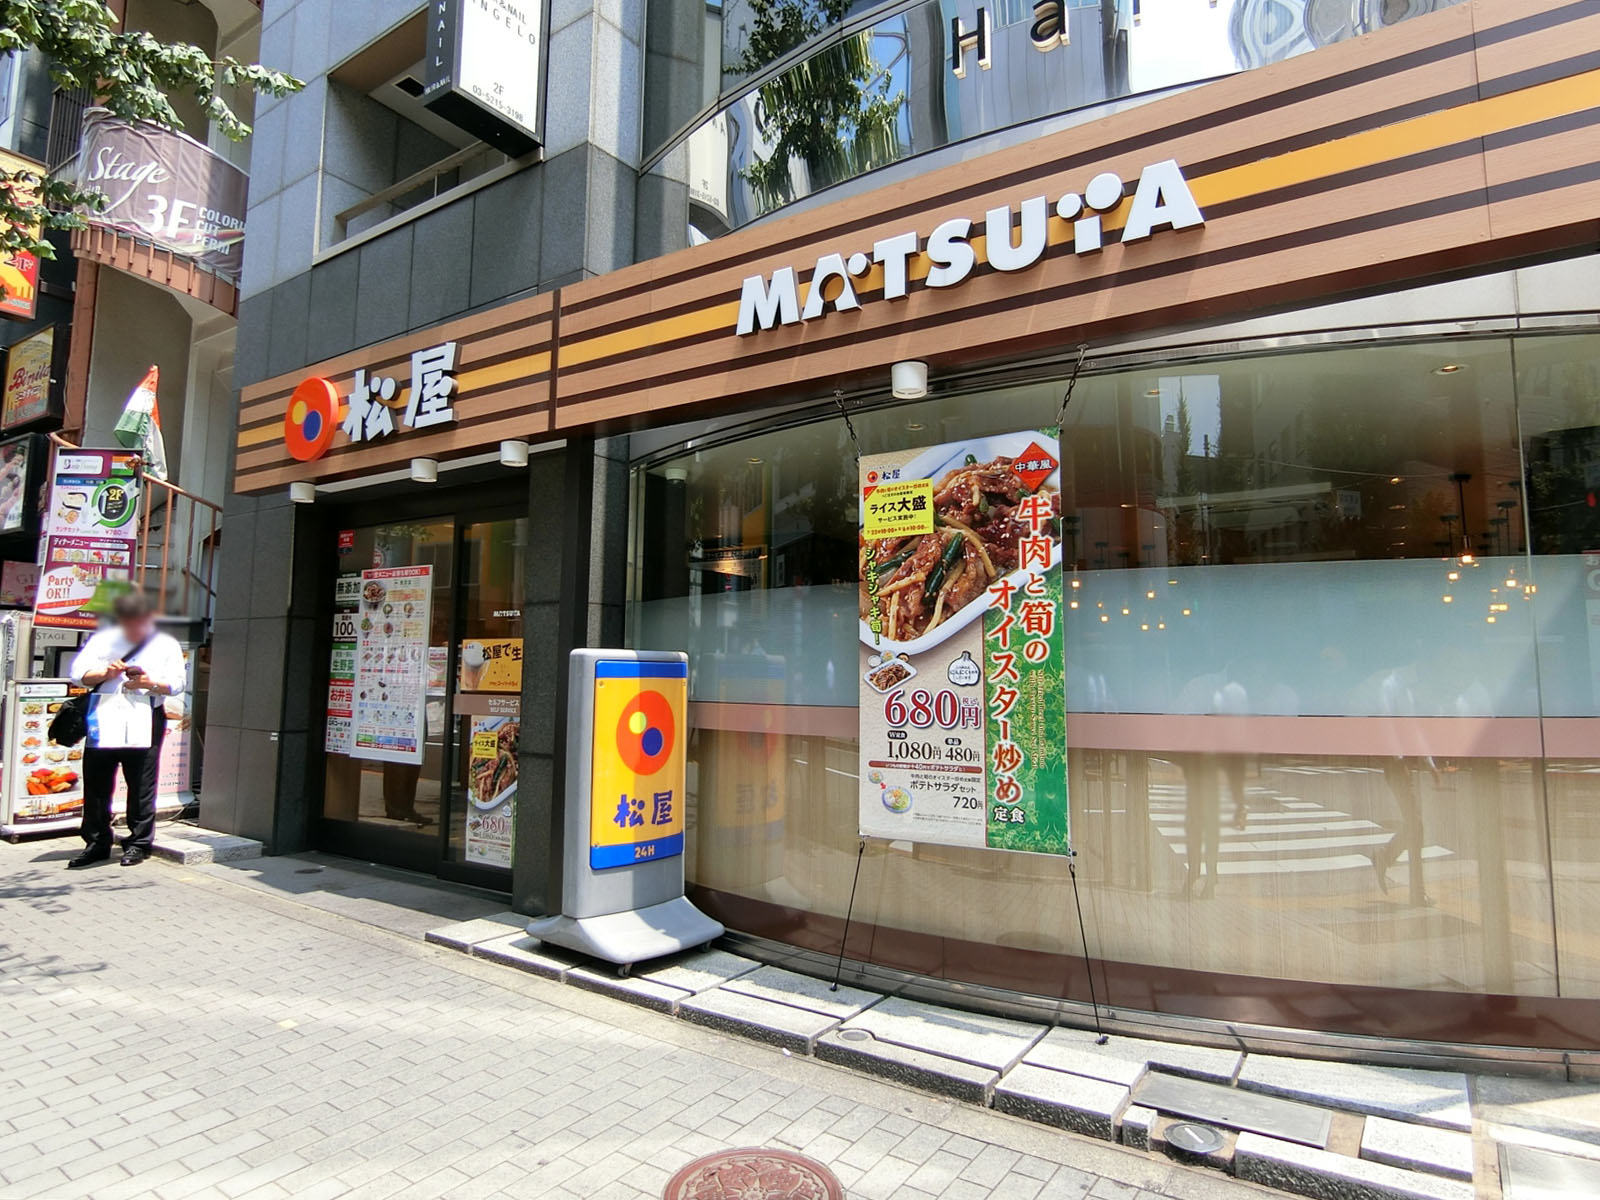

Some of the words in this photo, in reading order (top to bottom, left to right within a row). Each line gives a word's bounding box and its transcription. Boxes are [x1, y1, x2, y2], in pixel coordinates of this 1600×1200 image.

[493, 0, 526, 25] &NAIL
[473, 0, 536, 45] NGELO
[435, 1, 446, 67] NAIL
[493, 82, 504, 95] 2F
[87, 146, 170, 216] Stage
[147, 195, 197, 238] 3F
[199, 207, 245, 229] COLORI
[197, 220, 221, 237] CUT
[342, 342, 460, 442] 松屋
[1014, 457, 1052, 472] 中華風
[882, 469, 900, 480] 松屋
[109, 489, 124, 501] 2F
[870, 495, 927, 515] ライス大盛
[48, 575, 74, 587] Party
[1018, 495, 1053, 663] 牛肉と筍の
[46, 588, 71, 599] OK!!
[36, 632, 65, 641] STAGE
[482, 643, 522, 662] 松屋で生
[987, 579, 1024, 804] オイスター炒め
[613, 790, 673, 828] 松屋
[993, 806, 1025, 824] 定食
[634, 844, 655, 859] 24H
